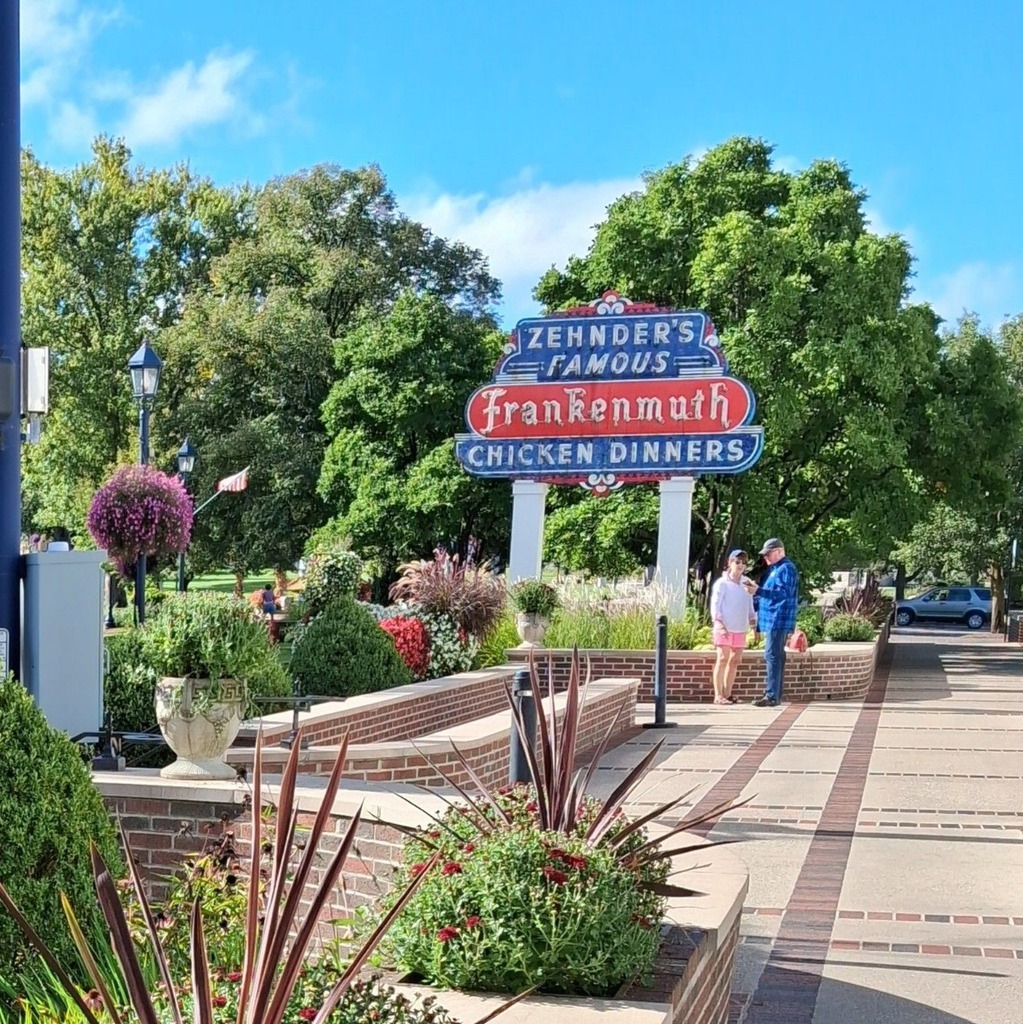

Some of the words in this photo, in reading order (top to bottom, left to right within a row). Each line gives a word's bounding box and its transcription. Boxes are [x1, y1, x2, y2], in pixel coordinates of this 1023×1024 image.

[527, 318, 694, 349] ZEHNDER'S
[546, 351, 671, 377] FAMOUS
[481, 381, 733, 433] Frankenmuth
[468, 442, 593, 468] CHICKEN
[610, 439, 744, 465] DINNERS
